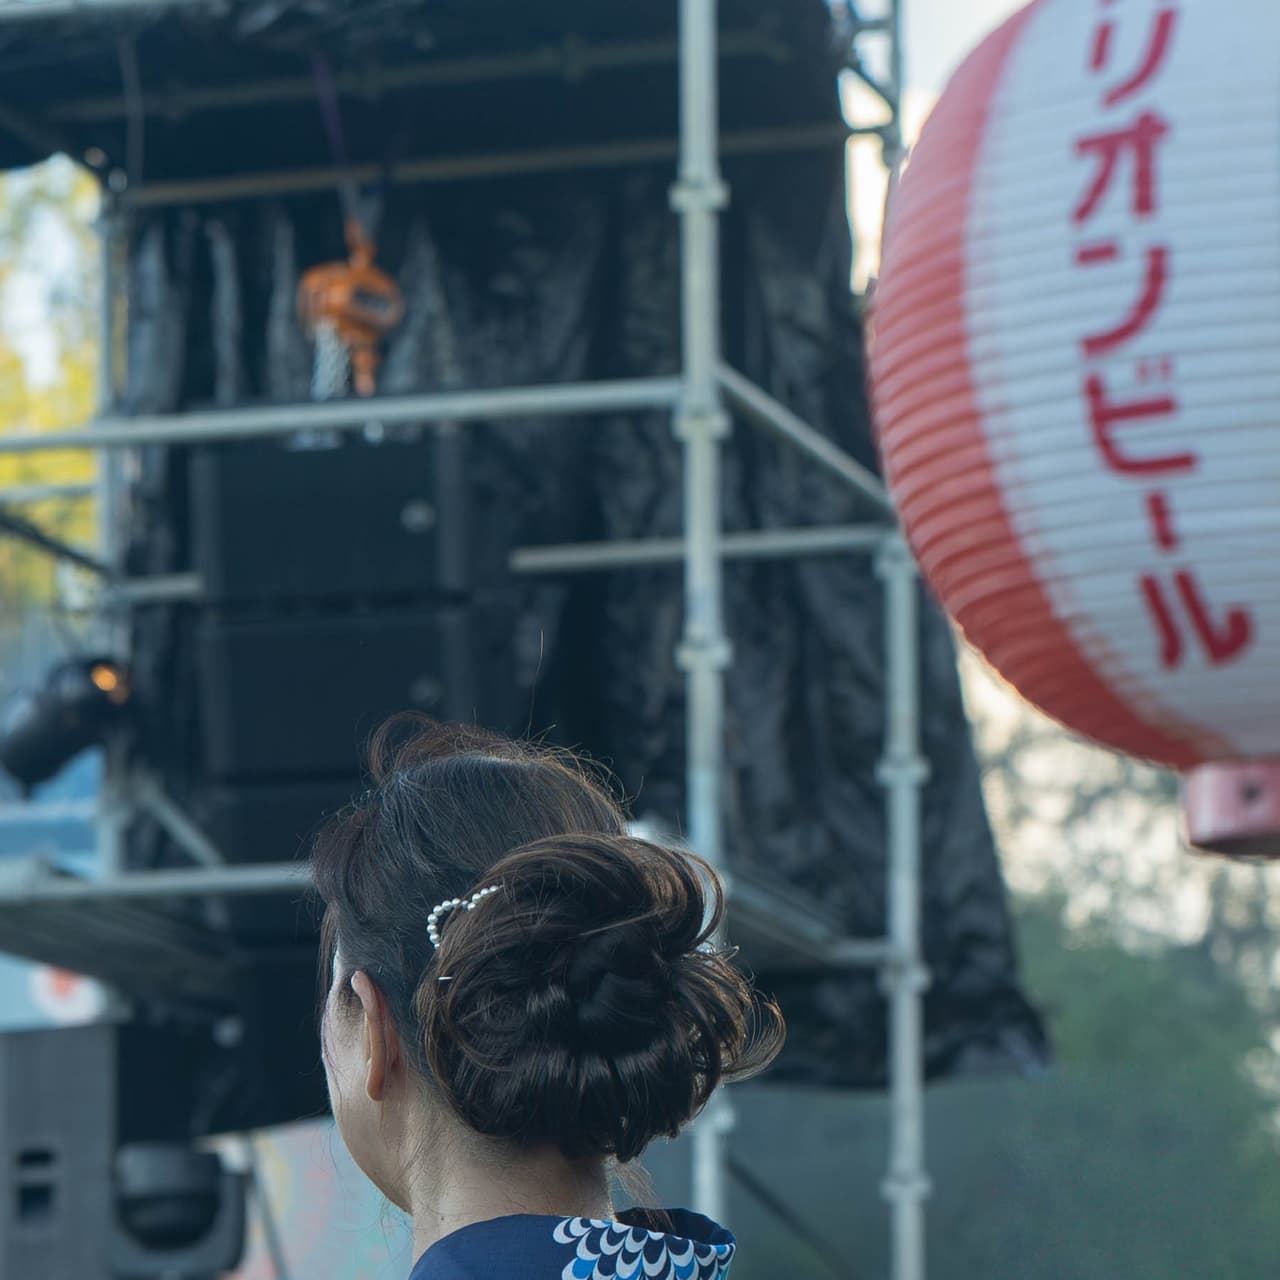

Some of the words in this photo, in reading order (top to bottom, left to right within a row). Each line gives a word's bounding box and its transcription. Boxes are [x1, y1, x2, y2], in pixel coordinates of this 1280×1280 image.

[1071, 0, 1253, 672] リオンビール
